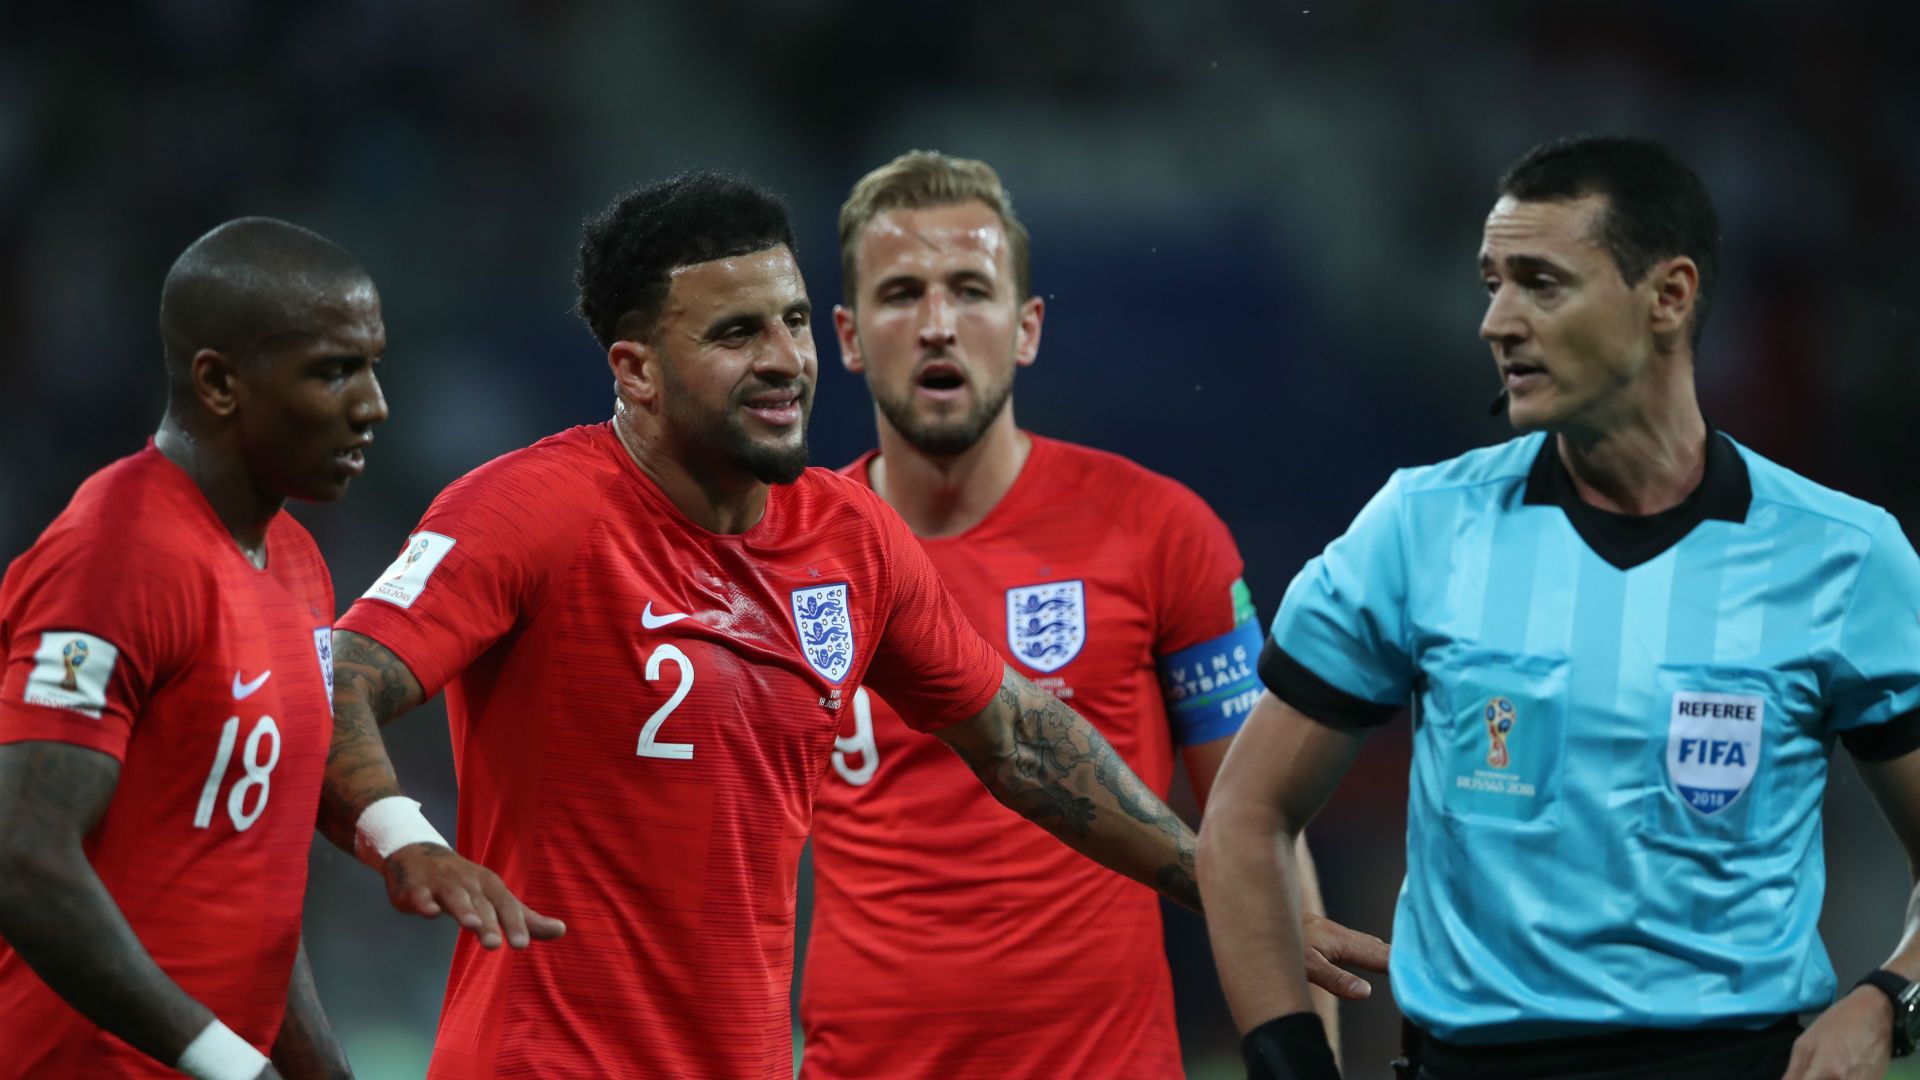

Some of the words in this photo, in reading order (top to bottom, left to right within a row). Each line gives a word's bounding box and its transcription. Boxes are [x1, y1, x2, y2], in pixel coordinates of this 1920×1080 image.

[636, 643, 695, 760] 2
[1221, 688, 1262, 719] FIFA
[1678, 701, 1757, 721] REFEREE
[831, 684, 880, 786] 9
[1678, 738, 1747, 767] FIFA
[193, 714, 281, 833] 18
[1691, 790, 1726, 808] 2018
